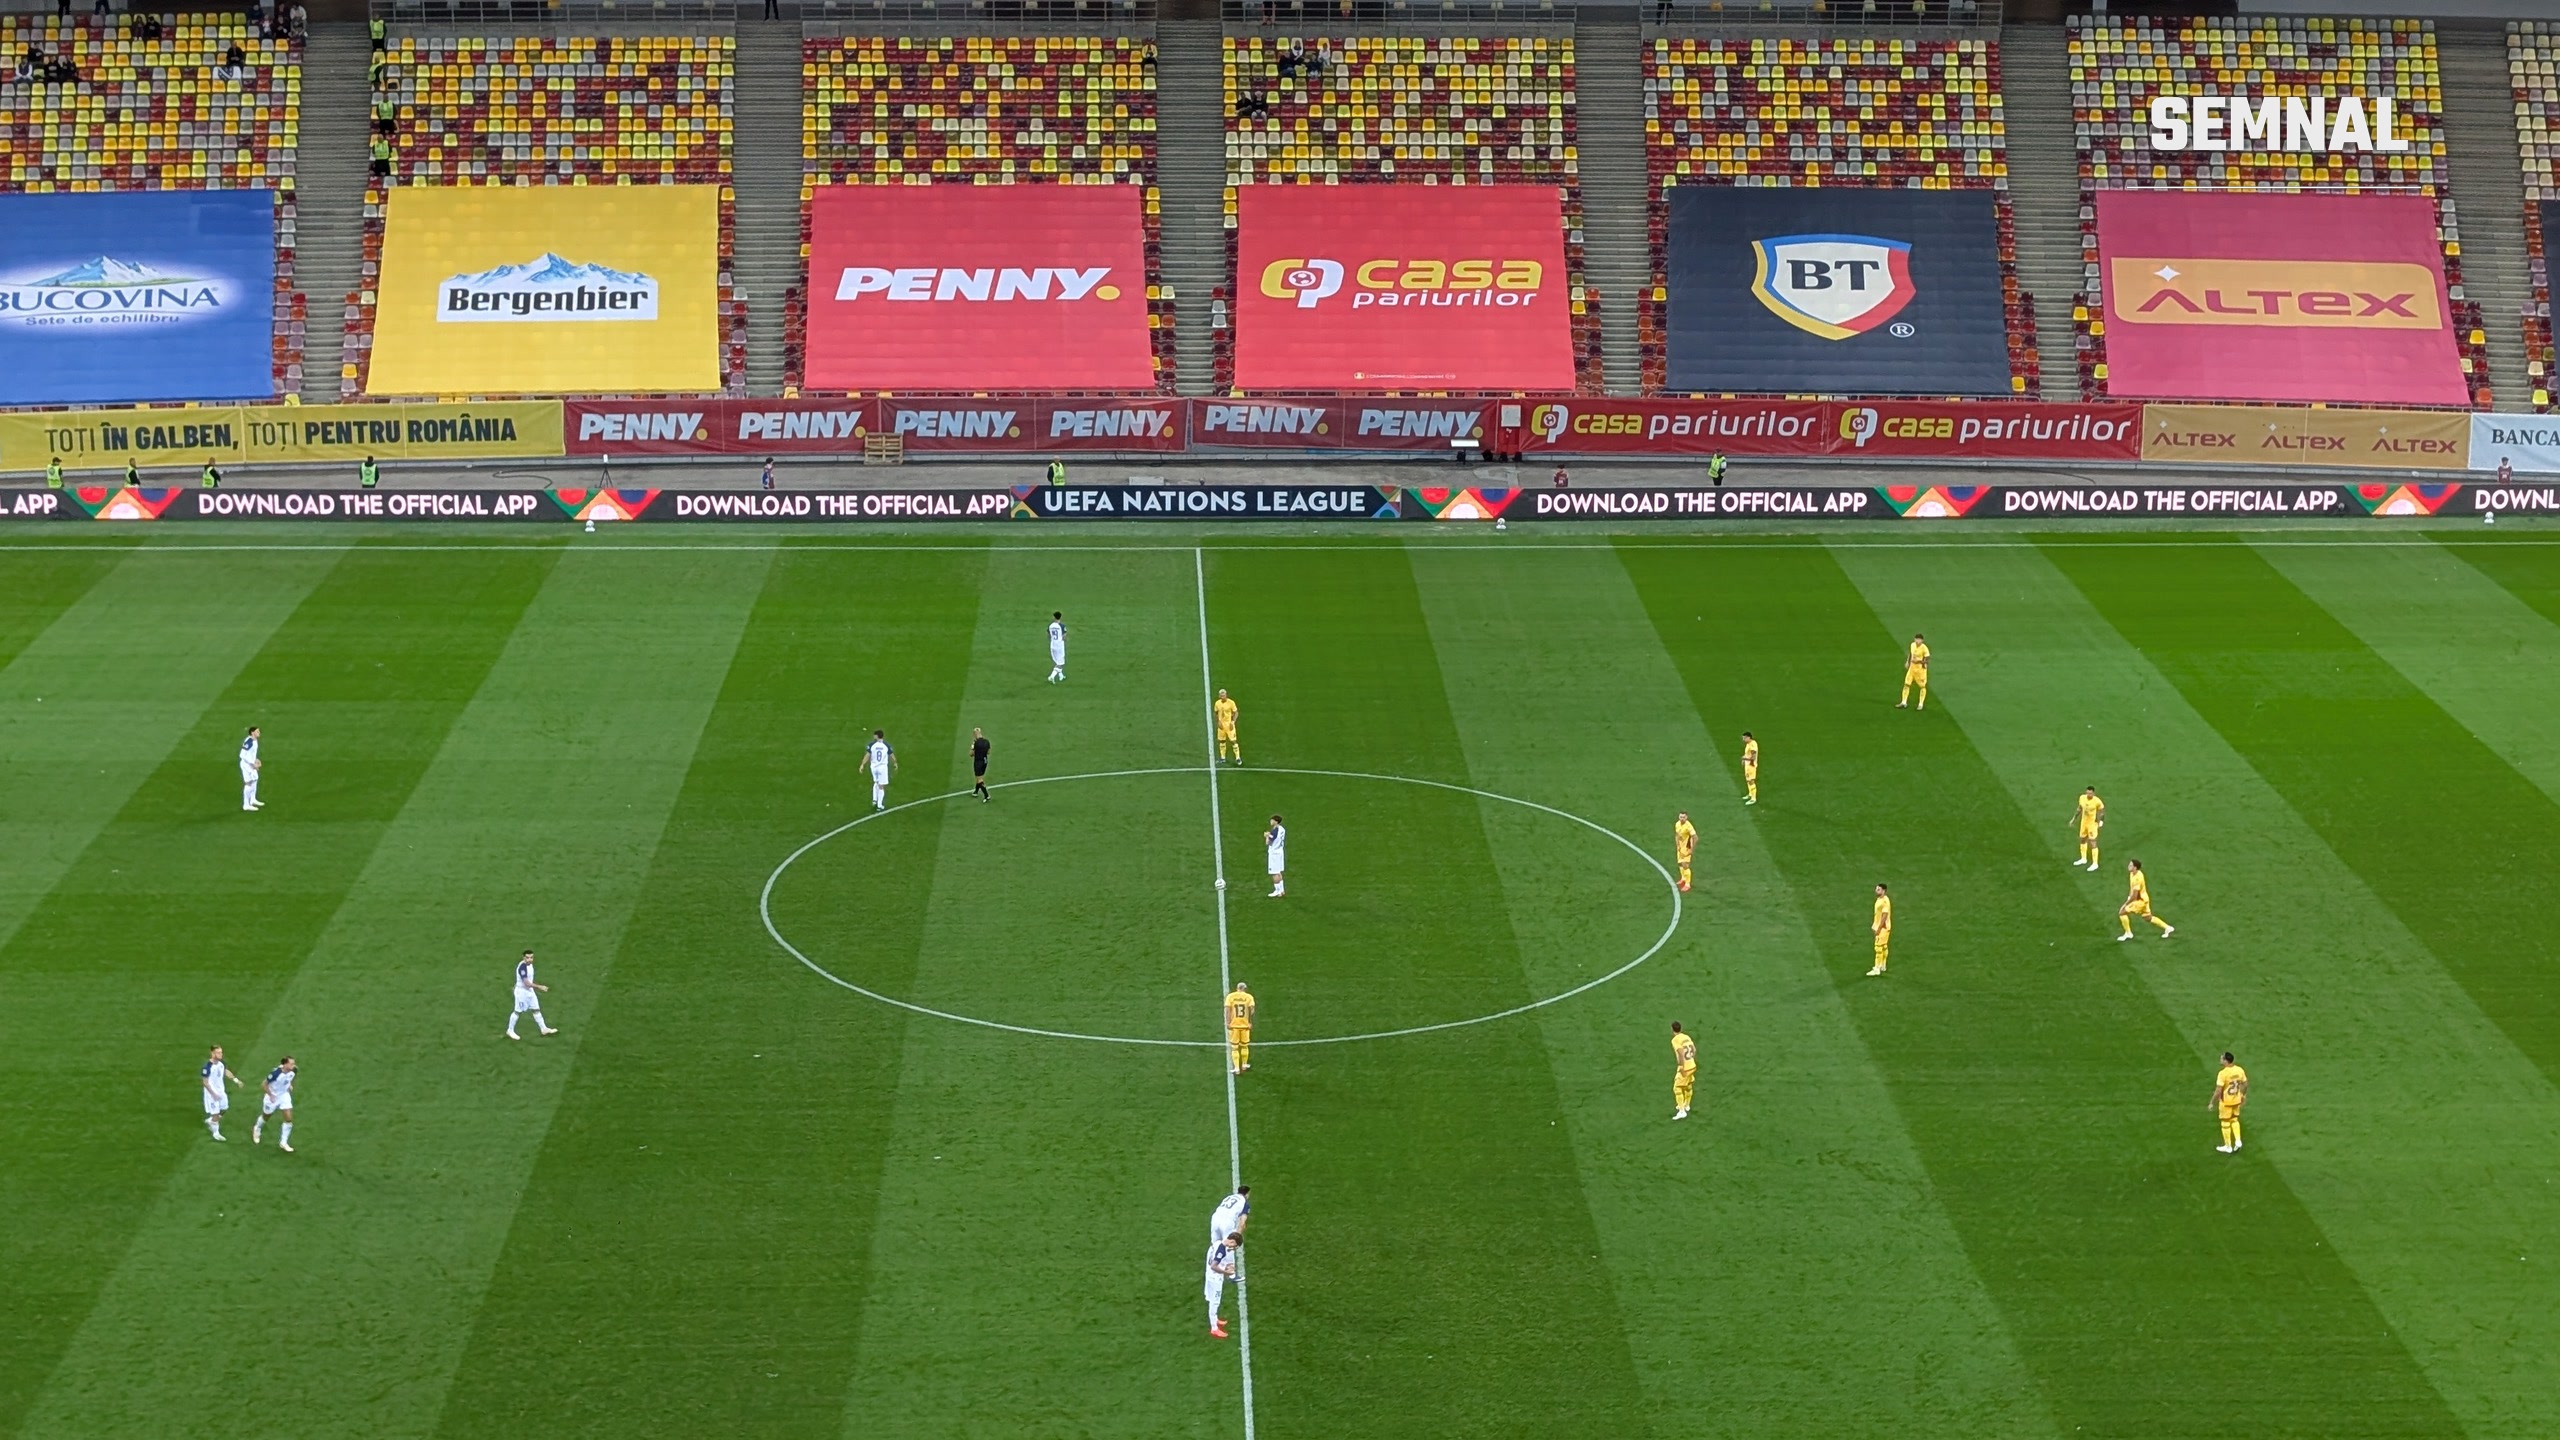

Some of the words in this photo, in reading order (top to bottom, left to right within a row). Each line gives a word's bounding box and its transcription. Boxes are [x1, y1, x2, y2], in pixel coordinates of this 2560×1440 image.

[1356, 259, 1543, 289] casa
[1786, 259, 1880, 291] BT
[447, 285, 648, 315] Bergenbier
[1352, 289, 1537, 309] pariurilor
[25, 316, 65, 326] Sete
[72, 314, 93, 325] de
[100, 313, 180, 324] echilibru
[100, 421, 128, 451] ÎN
[135, 423, 239, 450] GALBEN,
[305, 419, 400, 445] PENTRU
[407, 413, 517, 443] ROMÂNIA
[1573, 414, 1642, 434] casa
[1648, 409, 1816, 440] pariurilor
[1883, 417, 1954, 438] casa
[1959, 413, 2131, 444] pariurilor
[2491, 428, 2560, 446] BANCA
[13, 493, 58, 515] APP
[199, 494, 334, 515] DOWNLOAD
[340, 495, 383, 515] THE
[389, 494, 488, 515] OFFICIAL
[494, 495, 537, 515] APP
[677, 495, 810, 516] DOWNLOAD
[816, 495, 857, 515] THE
[864, 494, 961, 515] OFFICIAL
[966, 494, 1009, 515] APP
[1045, 490, 1114, 512] UEFA
[1123, 490, 1247, 512] NATIONS
[1257, 491, 1365, 512] LEAGUE
[1537, 493, 1669, 514] DOWNLOAD
[1674, 492, 1716, 513] THE
[1721, 492, 1818, 513] OFFICIAL
[1823, 492, 1868, 513] APP
[2005, 490, 2138, 512] DOWNLOAD
[2144, 490, 2185, 511] THE
[2191, 490, 2288, 511] OFFICIAL
[2293, 490, 2338, 511] APP
[2475, 489, 2560, 510] DOWNL
[1234, 1004, 1246, 1018] 13
